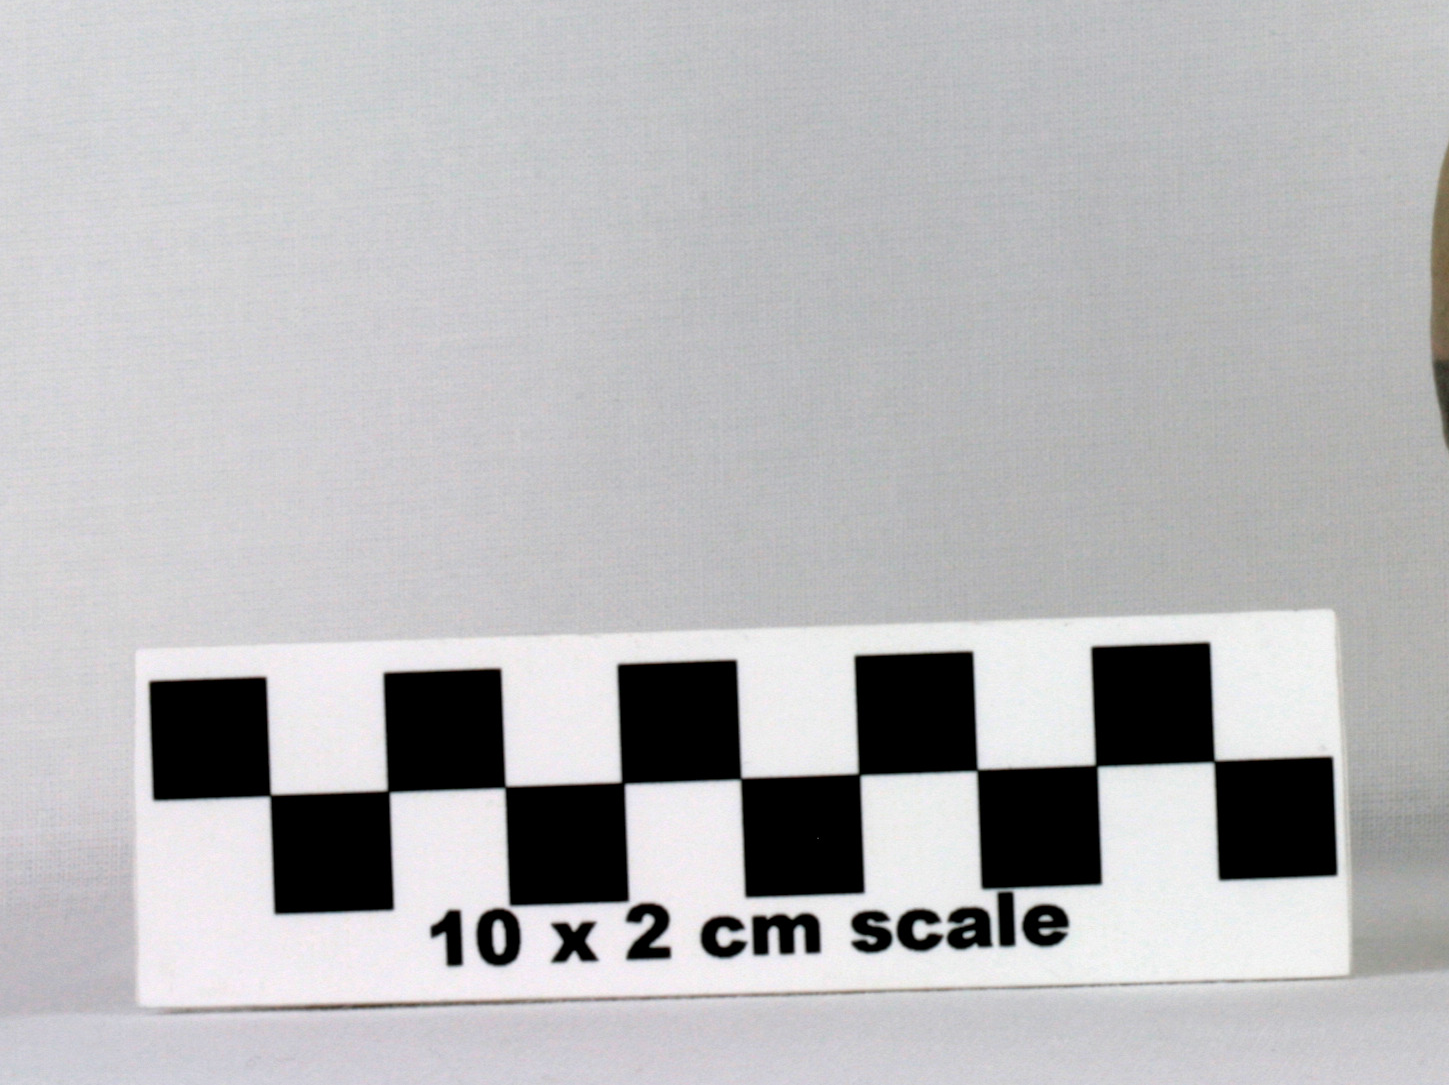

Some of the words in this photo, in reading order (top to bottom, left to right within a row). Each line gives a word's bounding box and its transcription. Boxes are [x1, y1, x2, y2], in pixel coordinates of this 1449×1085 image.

[430, 908, 522, 967] 10
[550, 920, 598, 963] x
[625, 902, 672, 961] 2
[700, 913, 821, 959] cm
[851, 891, 1070, 954] scale
